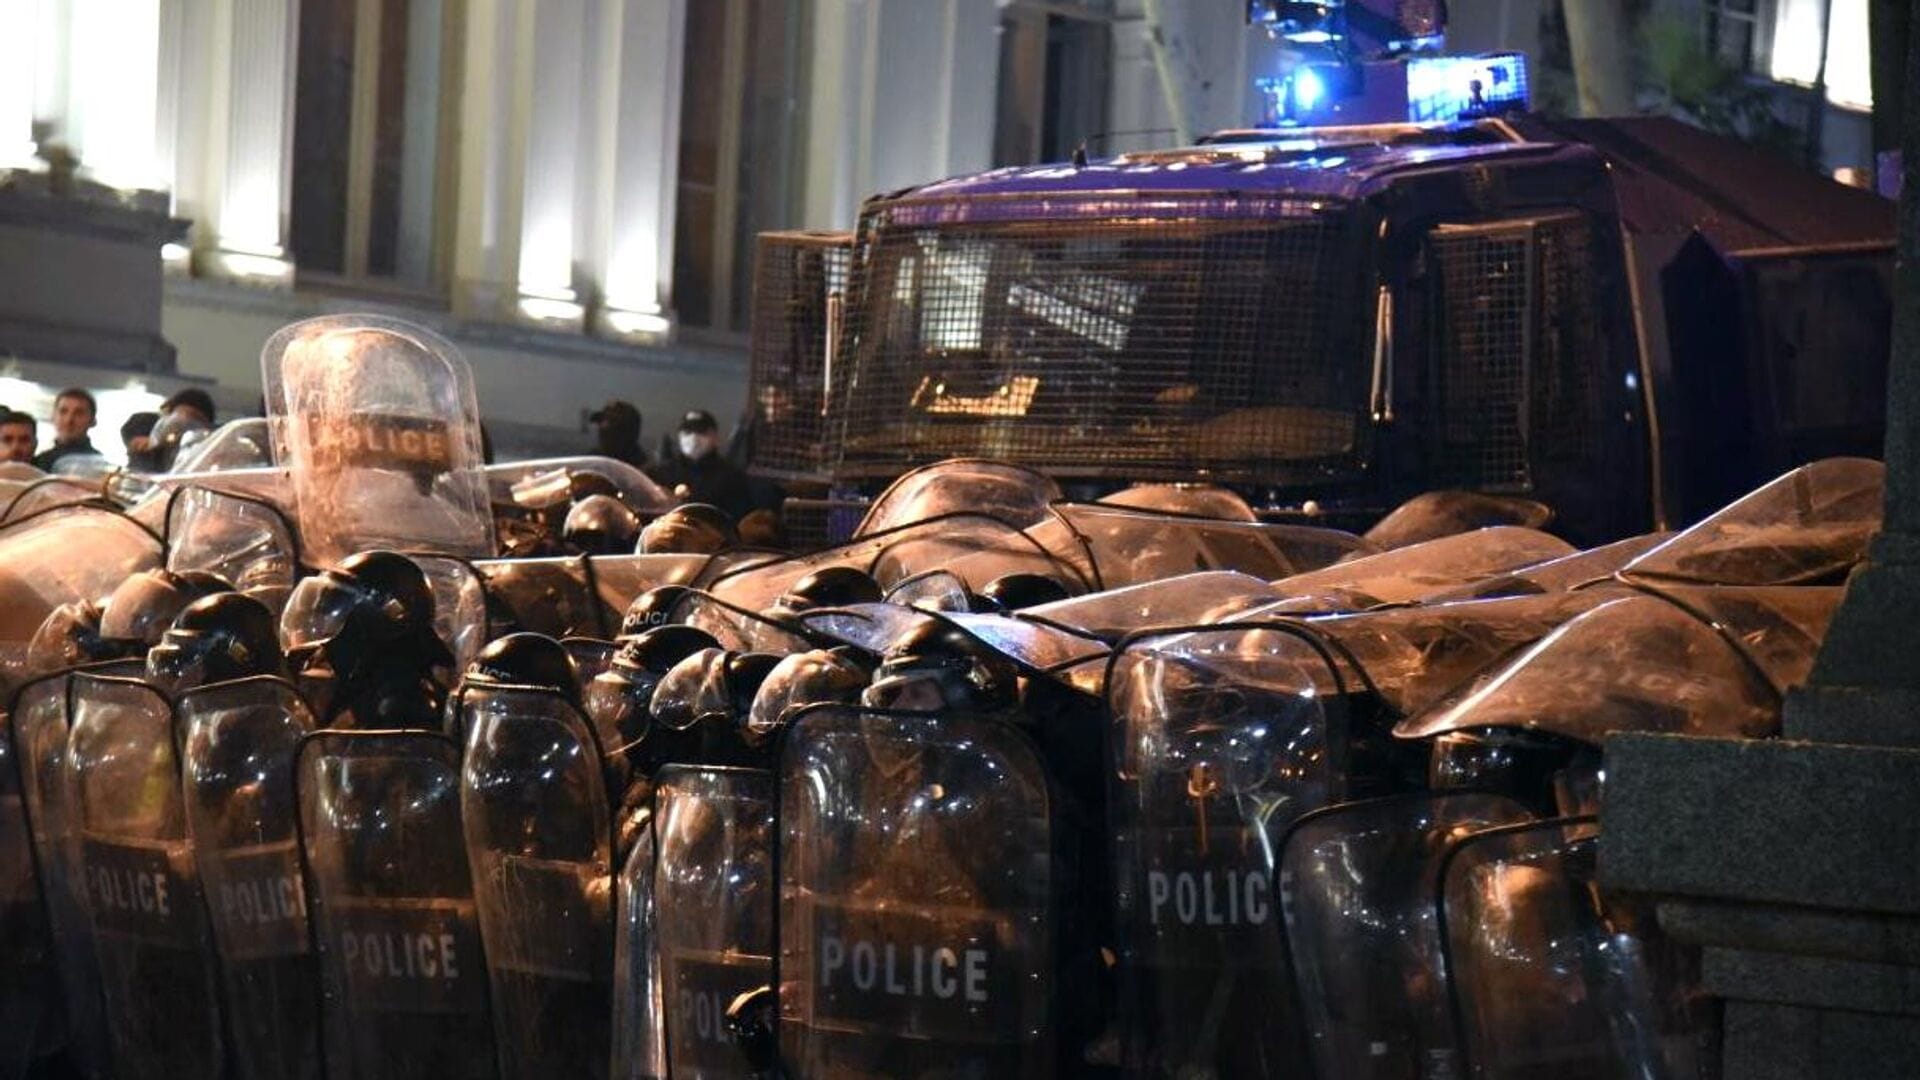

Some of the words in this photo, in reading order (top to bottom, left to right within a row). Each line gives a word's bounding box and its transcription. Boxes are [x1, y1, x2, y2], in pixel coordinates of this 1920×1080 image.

[1149, 870, 1295, 925] POLICE
[342, 931, 459, 979] POLICE
[821, 936, 988, 1002] POLICE
[680, 988, 728, 1043] POL
